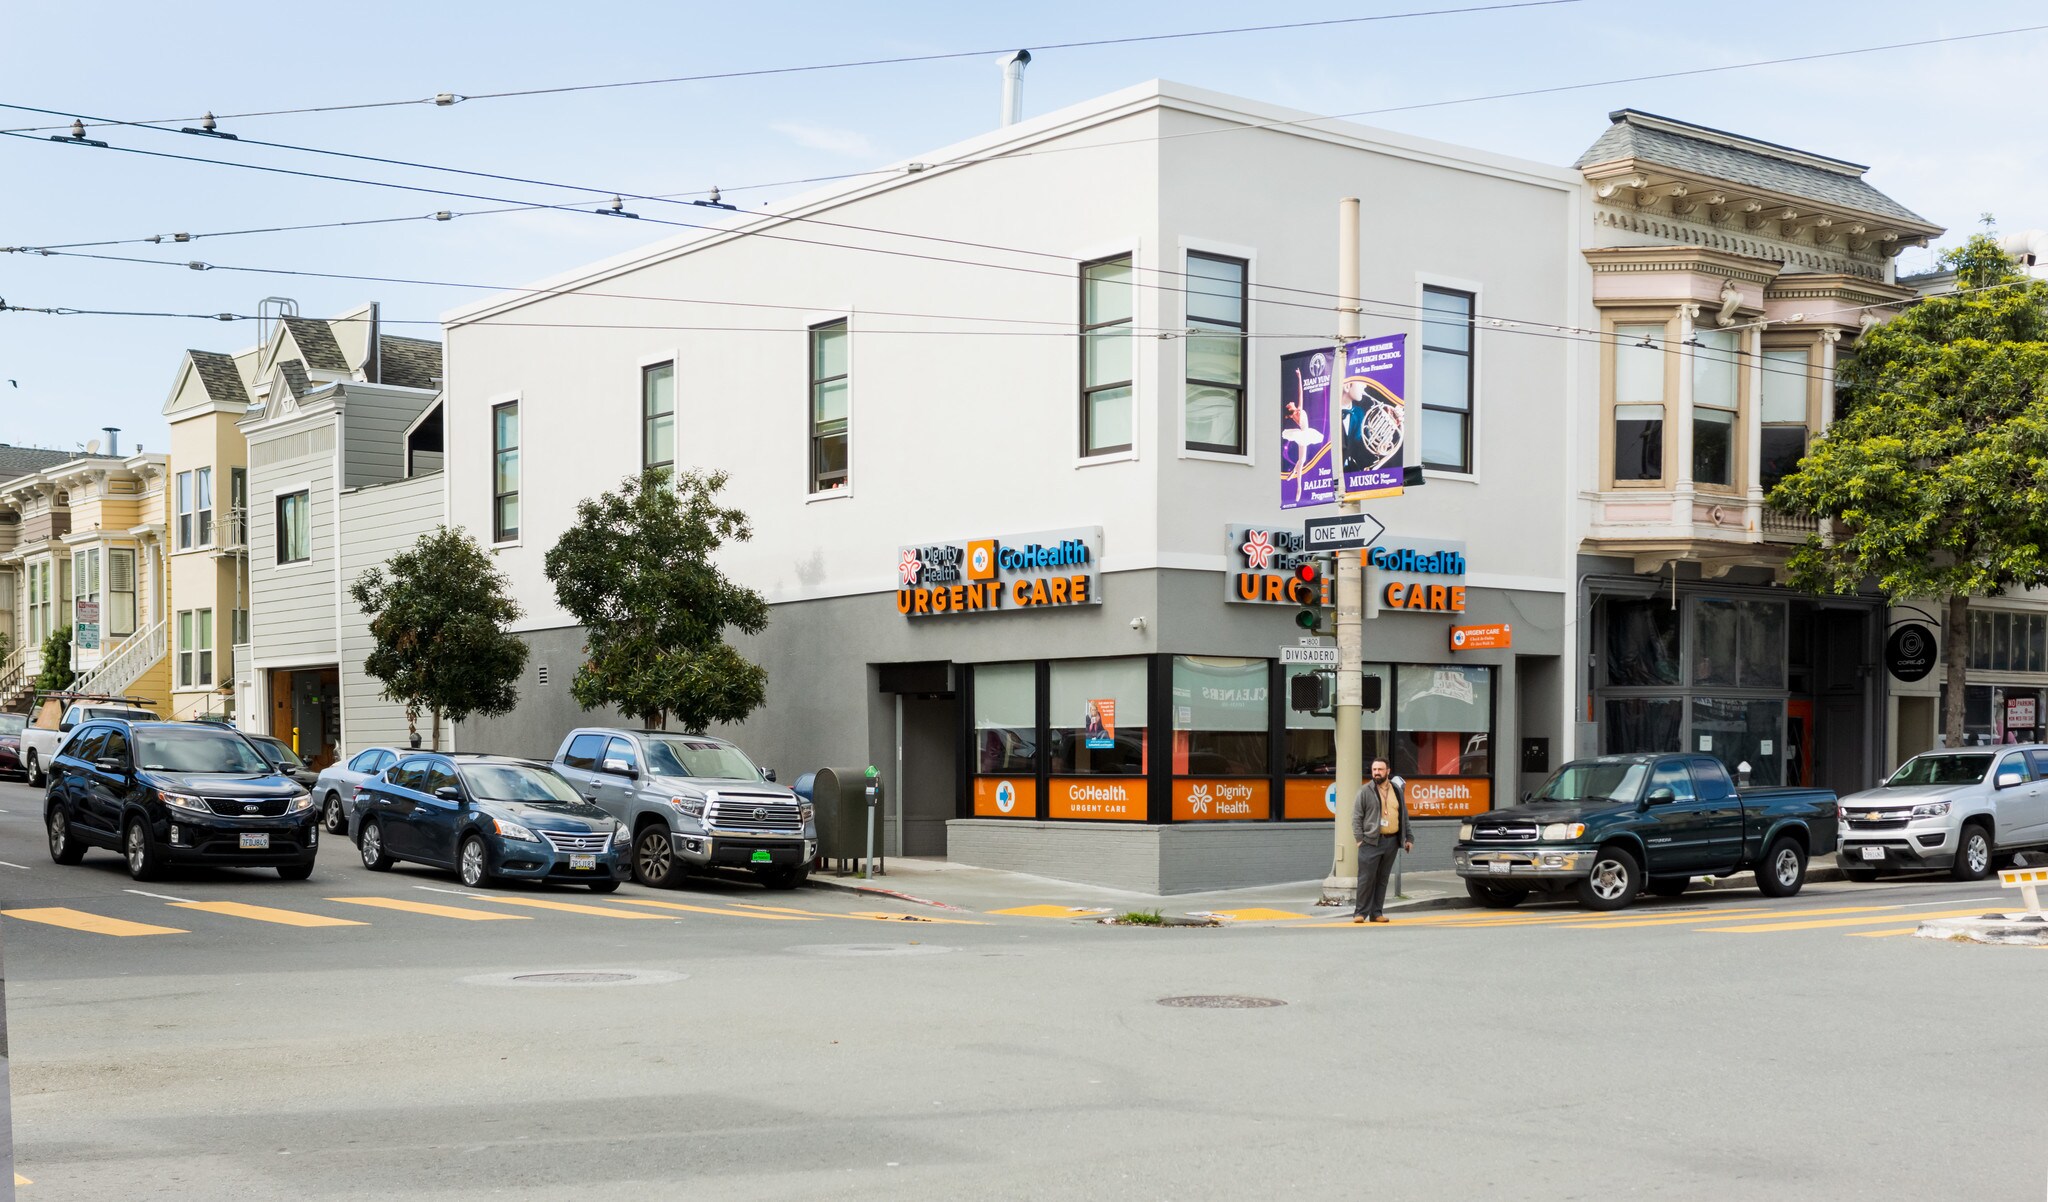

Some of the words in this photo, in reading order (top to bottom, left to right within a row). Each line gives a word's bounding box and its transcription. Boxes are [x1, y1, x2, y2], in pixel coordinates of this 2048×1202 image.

[1357, 346, 1369, 355] THE
[1369, 342, 1394, 353] PREMIER
[1348, 357, 1362, 366] ARTS
[1362, 354, 1378, 363] HIGH
[1378, 350, 1401, 361] SCHOOL
[1303, 478, 1332, 491] BALLET
[1349, 473, 1379, 488] MUSIC
[1314, 527, 1336, 541] ONE
[1340, 525, 1362, 539] WAY
[922, 546, 959, 565] Dignity
[998, 538, 1086, 570] GoHealth
[1371, 546, 1465, 575] GoHealth
[922, 566, 957, 583] Health
[896, 581, 1001, 614] URGENT
[1012, 574, 1086, 606] CARE
[1386, 581, 1466, 611] CARE
[1306, 638, 1319, 646] 1800
[1285, 649, 1335, 661] DIVISADERO
[1069, 784, 1127, 802] GoHealth
[1216, 784, 1253, 800] Dignity
[1411, 784, 1470, 799] GoHealth
[1070, 803, 1103, 812] URGENT
[1105, 804, 1127, 813] CARE
[1216, 800, 1250, 814] Health
[1413, 802, 1446, 810] URGENT
[1448, 802, 1470, 810] CARE
